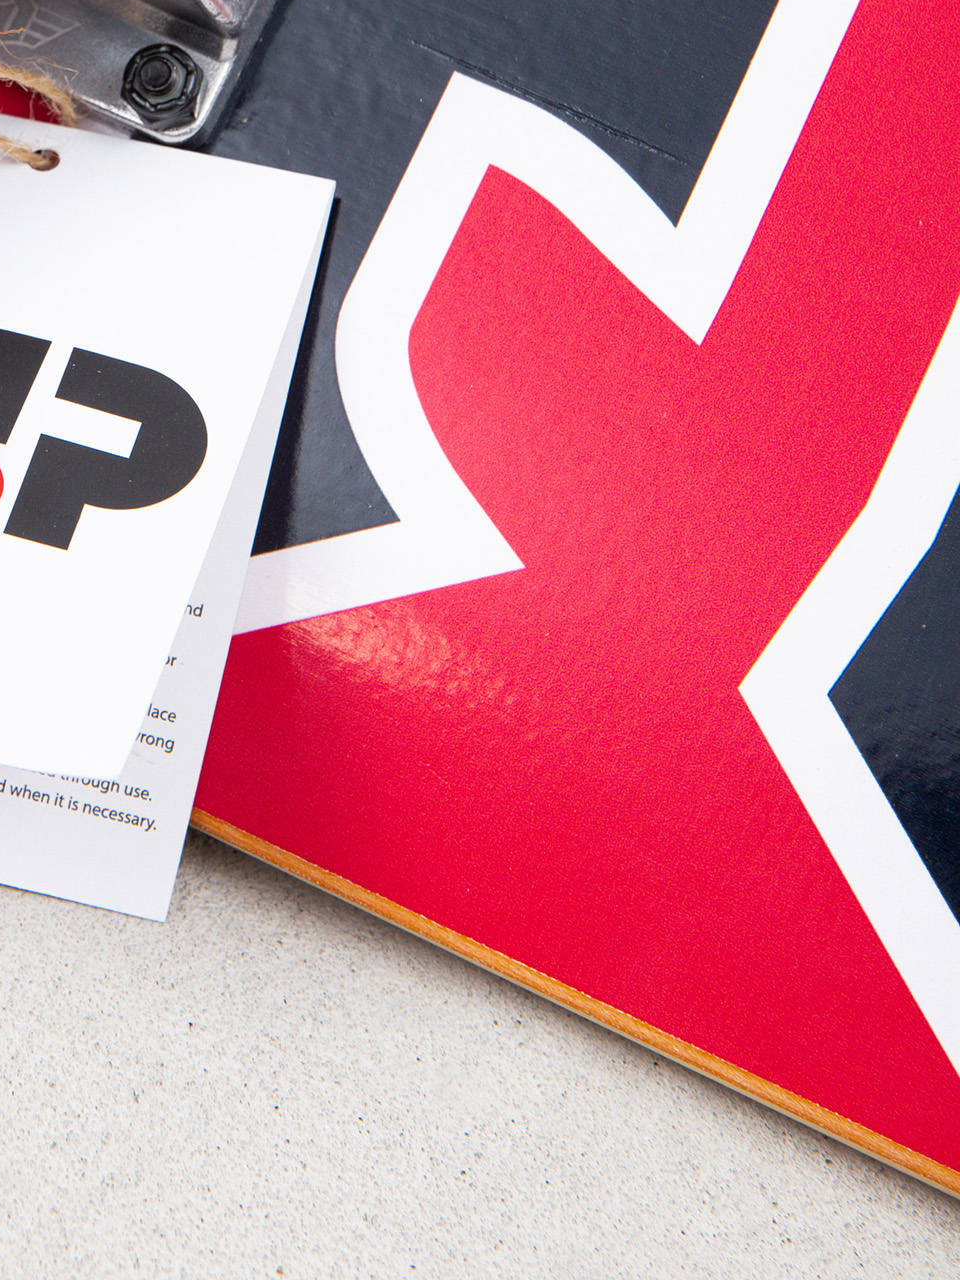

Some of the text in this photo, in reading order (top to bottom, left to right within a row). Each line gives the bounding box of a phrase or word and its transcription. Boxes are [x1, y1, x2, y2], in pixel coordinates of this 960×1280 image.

[184, 604, 204, 618] nd
[147, 703, 177, 723] lace
[136, 732, 175, 754] rong
[124, 785, 152, 802] use.
[10, 784, 50, 805] when
[54, 793, 65, 808] it
[68, 796, 79, 812] is
[82, 802, 157, 832] necessary.
